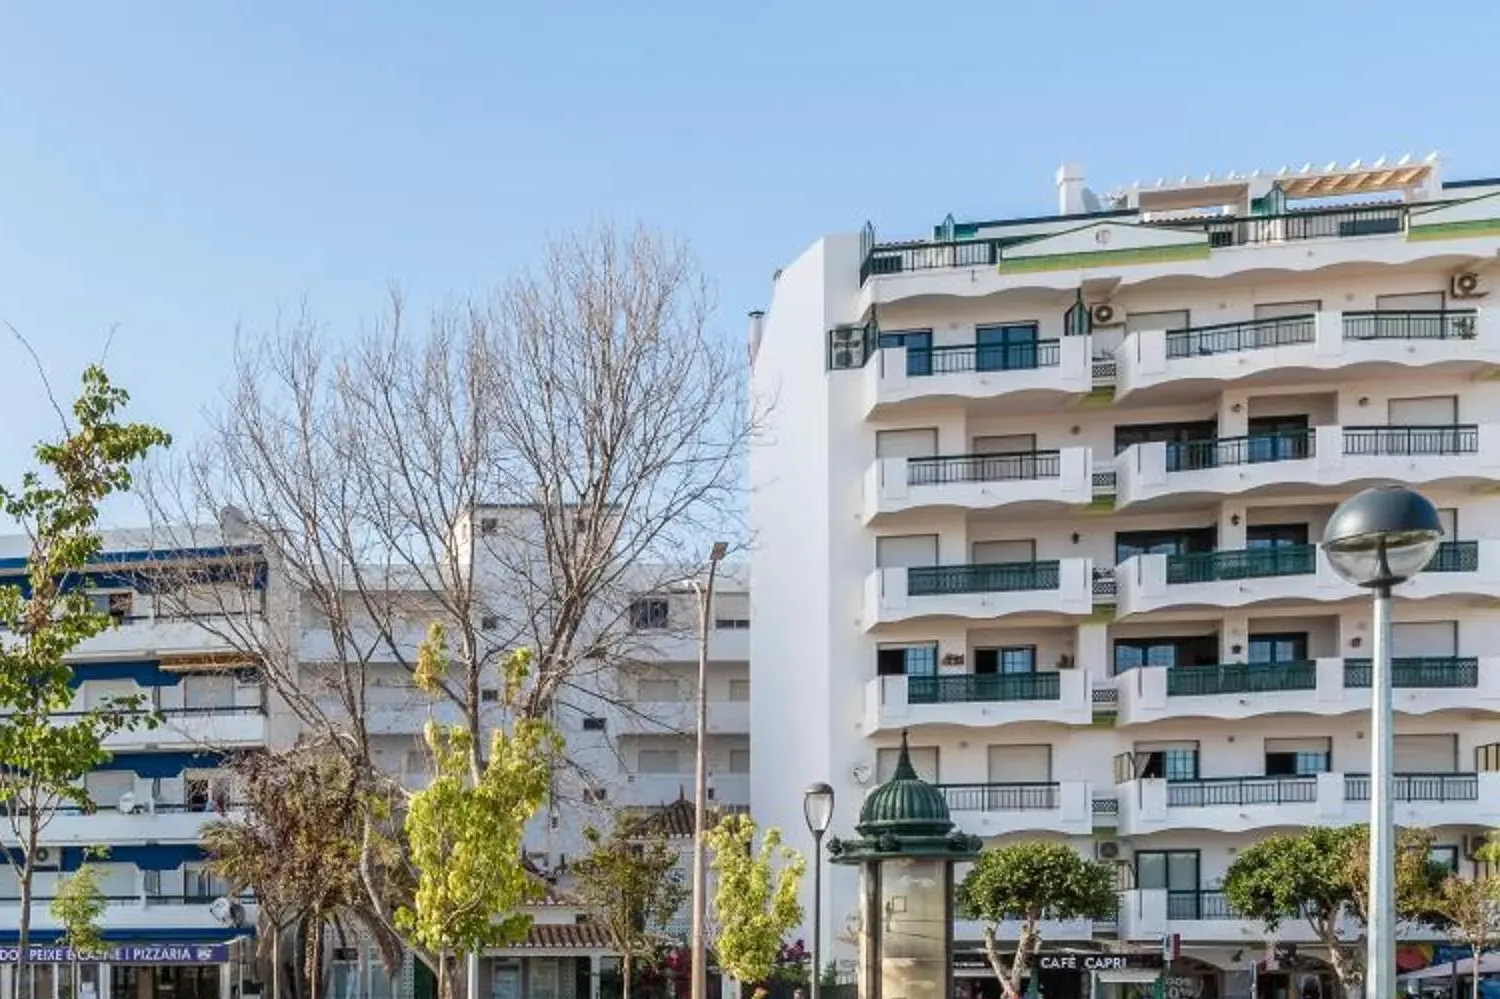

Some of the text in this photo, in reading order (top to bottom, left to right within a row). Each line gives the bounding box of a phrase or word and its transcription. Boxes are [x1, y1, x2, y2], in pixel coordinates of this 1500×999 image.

[29, 948, 62, 960] PEIXE
[133, 948, 191, 961] PIZZARIA
[1040, 954, 1127, 969] CAFÉ CAPRI
